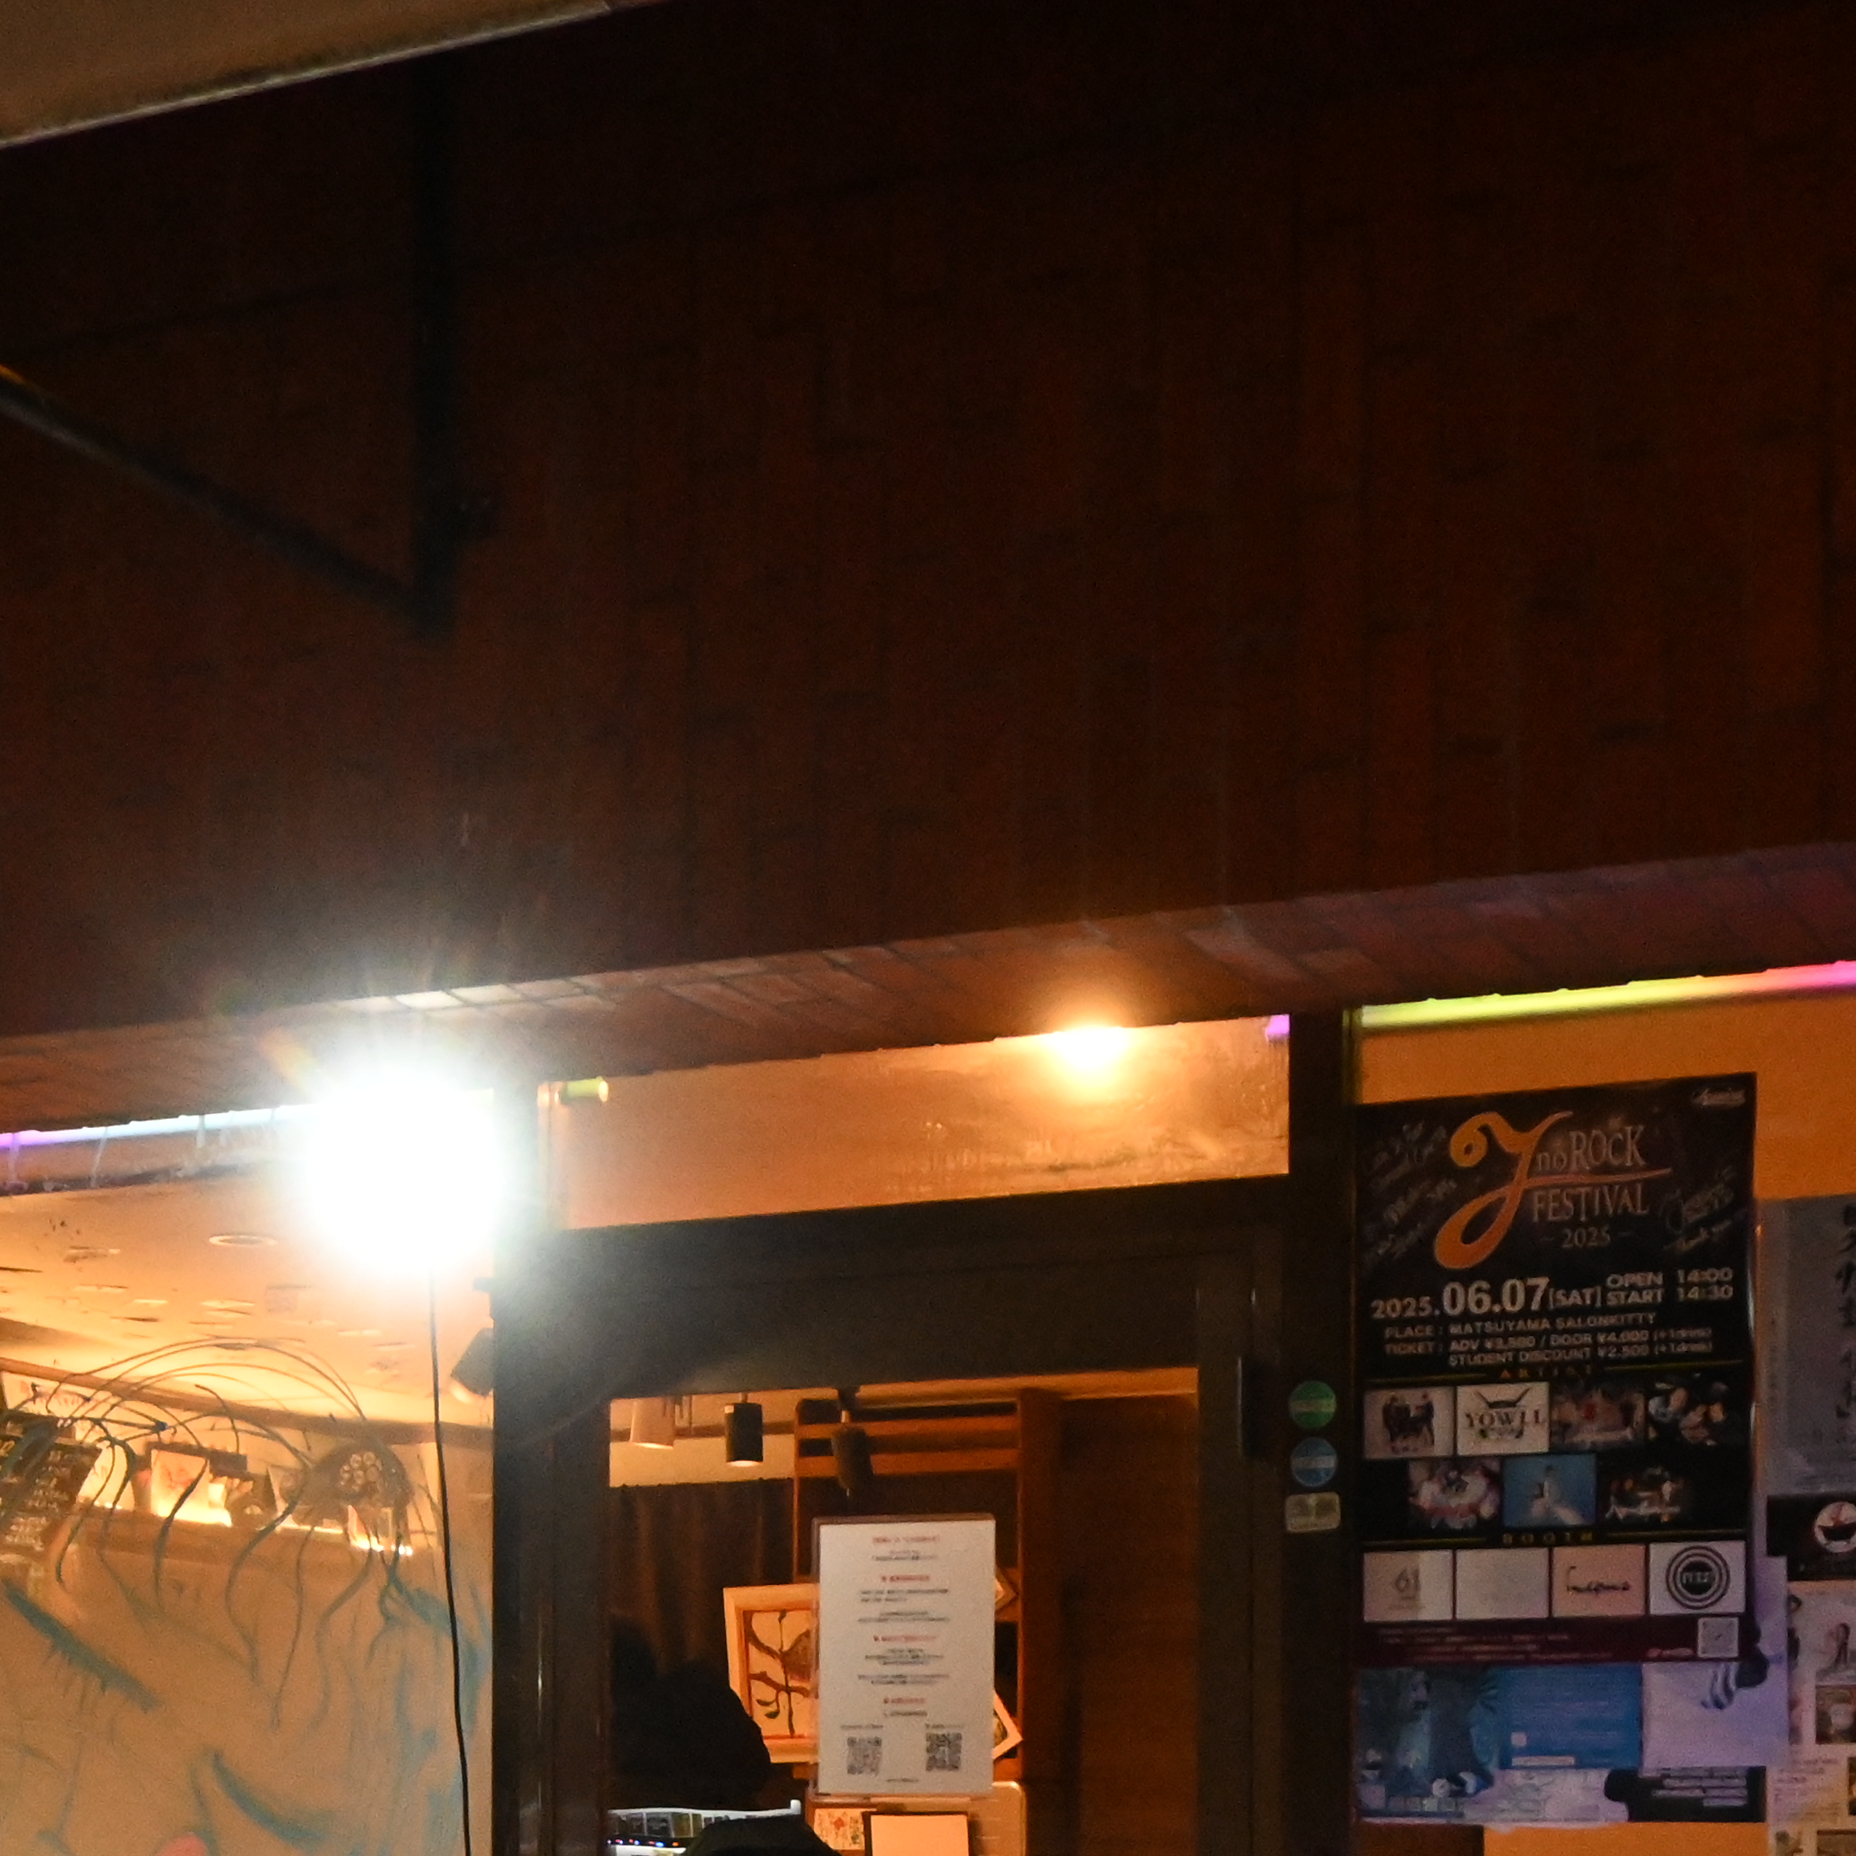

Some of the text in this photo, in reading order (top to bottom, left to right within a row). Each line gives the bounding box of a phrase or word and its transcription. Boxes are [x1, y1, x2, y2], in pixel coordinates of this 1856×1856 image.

[1569, 1124, 1646, 1171] ROCK
[1532, 1182, 1648, 1223] FESTIVAL
[1561, 1227, 1611, 1249] 2025
[1605, 1267, 1734, 1289] OPEN 14:00
[1605, 1288, 1664, 1307] START
[1449, 1319, 1551, 1336] MATSUYAMA
